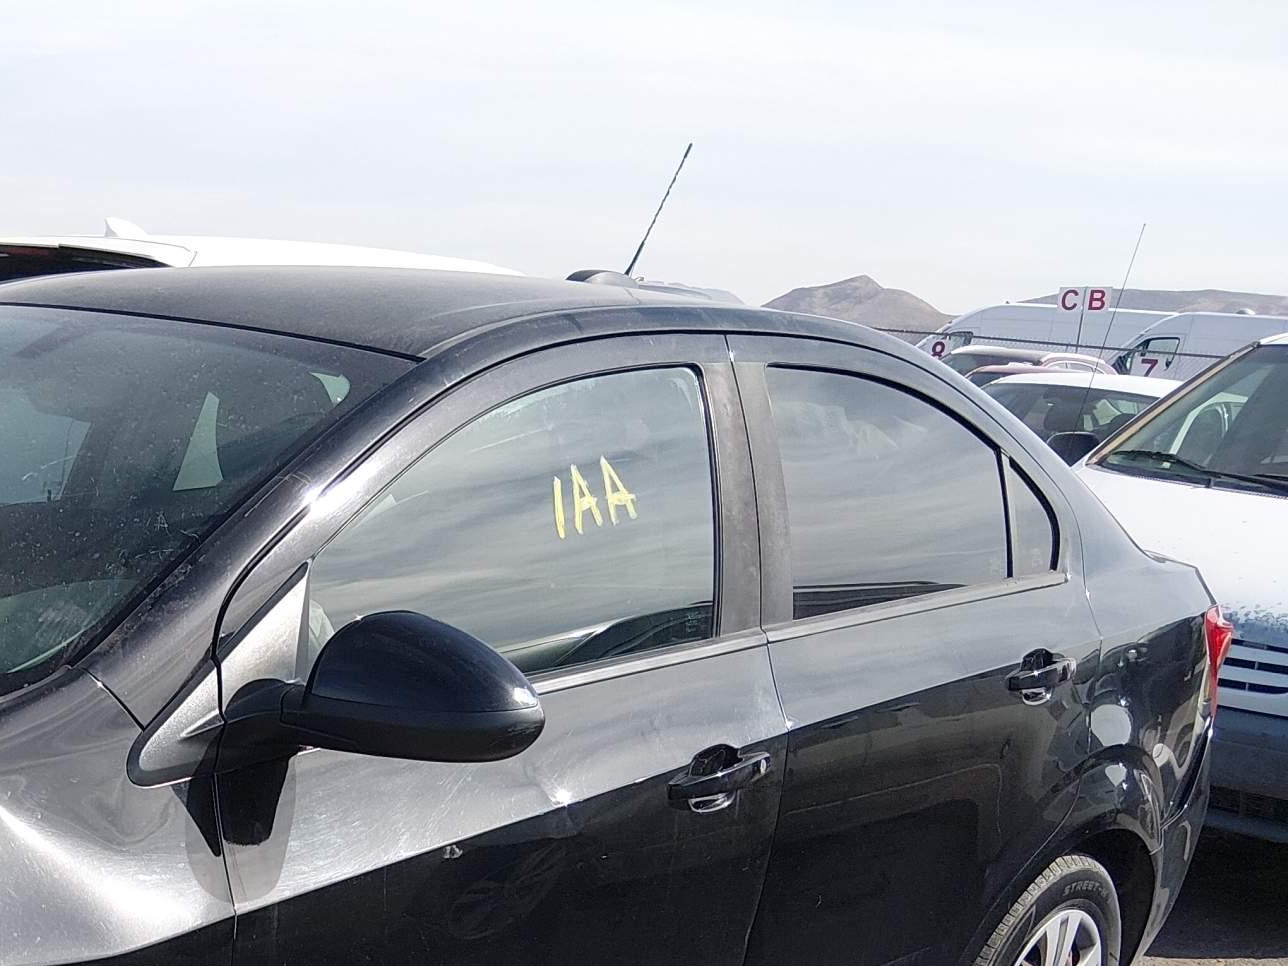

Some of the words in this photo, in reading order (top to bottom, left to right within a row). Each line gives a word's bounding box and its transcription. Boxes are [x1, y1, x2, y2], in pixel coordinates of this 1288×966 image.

[1061, 289, 1080, 311] C
[1087, 289, 1106, 311] B
[1141, 358, 1159, 377] 7
[552, 455, 638, 540] IAA
